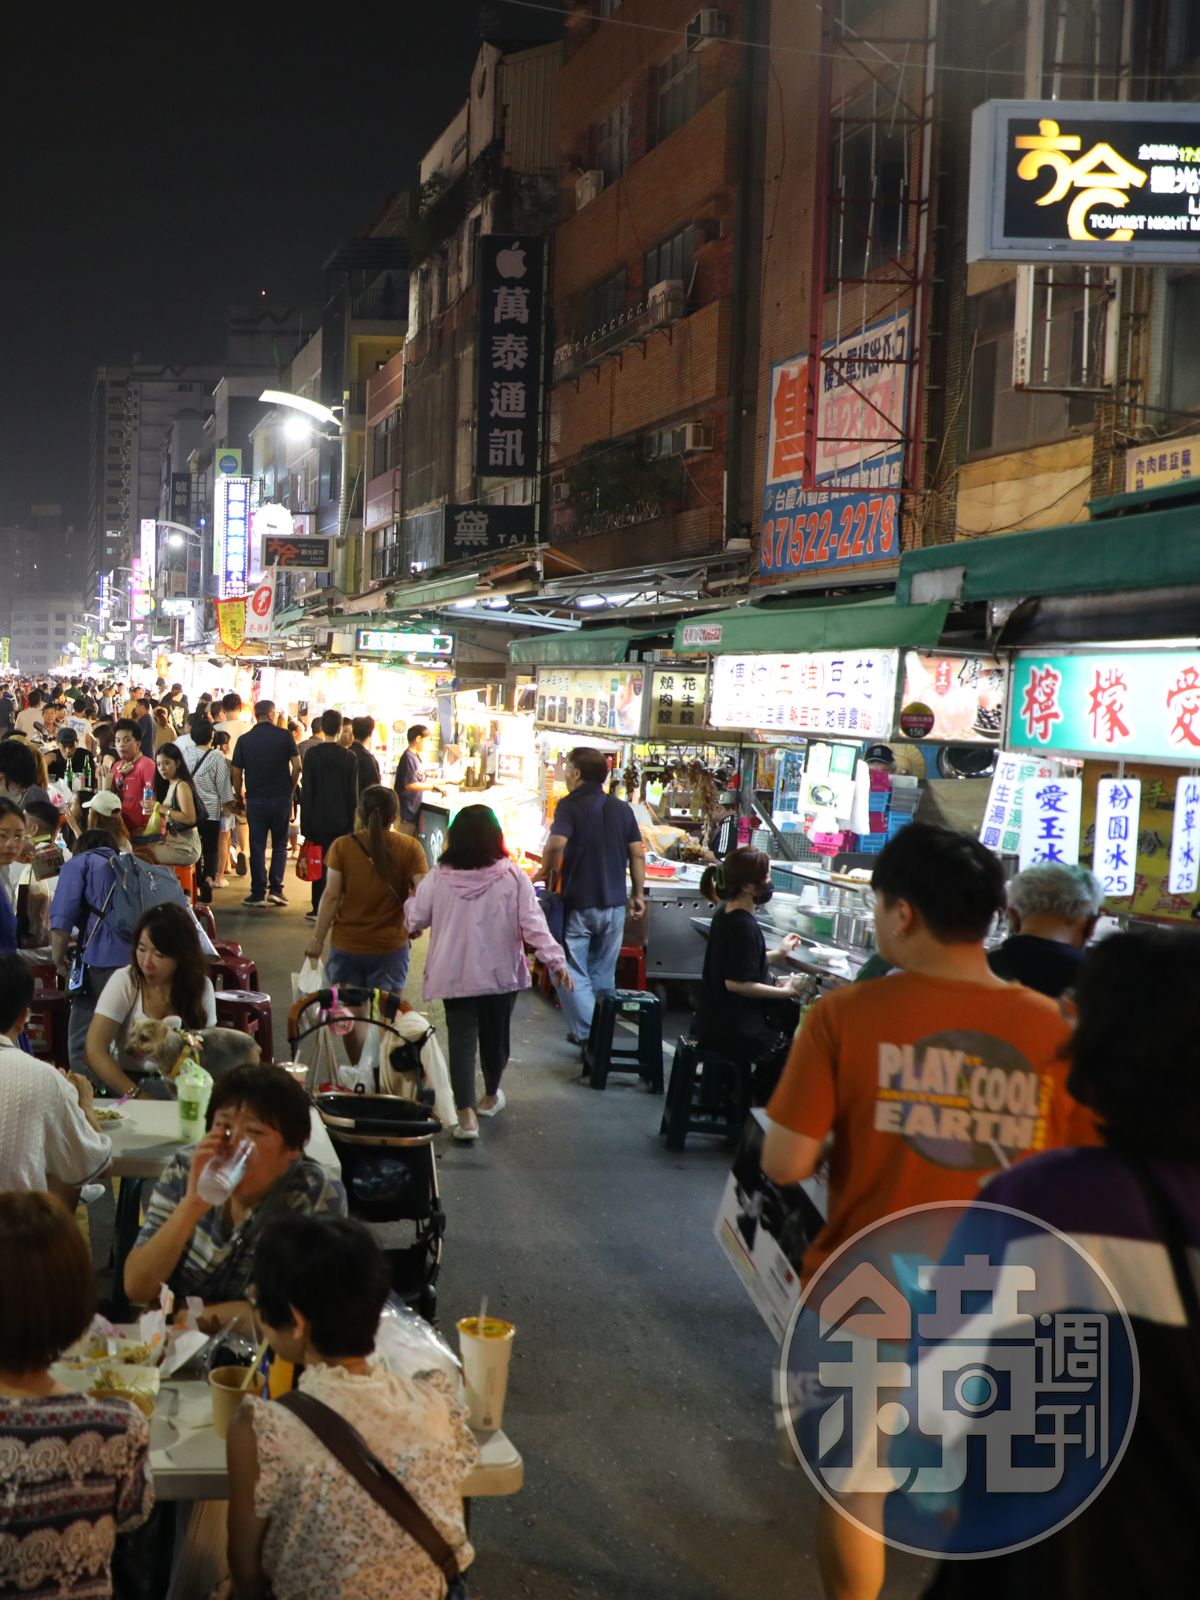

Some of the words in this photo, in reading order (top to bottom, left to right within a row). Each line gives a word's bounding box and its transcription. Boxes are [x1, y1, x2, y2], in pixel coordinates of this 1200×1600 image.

[1090, 214, 1147, 230] TOURIST
[1148, 215, 1189, 230] NIGHT
[489, 285, 530, 467] 萬泰通訊
[454, 510, 489, 546] 黛
[984, 761, 1016, 846] 花生湯圓
[1031, 784, 1069, 864] 愛玉冰
[1105, 784, 1134, 870] 粉圓冰
[1178, 783, 1200, 868] 仙草冰
[1104, 876, 1127, 892] 25
[1176, 873, 1193, 890] 25
[879, 1042, 965, 1095] PLAY
[970, 1064, 1040, 1117] COOL
[874, 1101, 1035, 1150] EARTH
